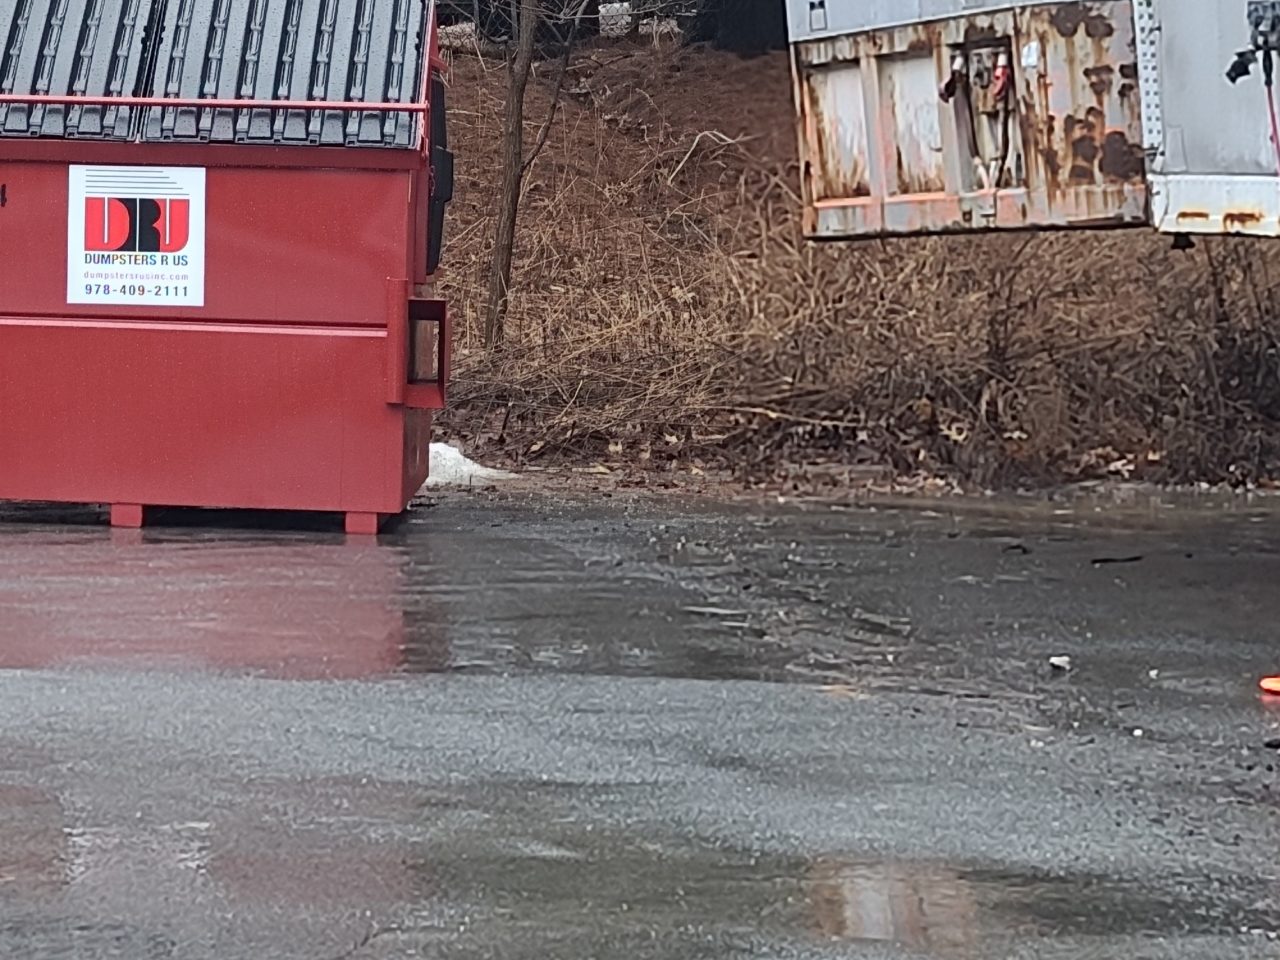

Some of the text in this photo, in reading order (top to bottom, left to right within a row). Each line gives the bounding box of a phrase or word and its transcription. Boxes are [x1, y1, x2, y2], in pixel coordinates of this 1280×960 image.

[84, 196, 190, 253] DRU
[84, 253, 189, 267] DUMPSTERS R US
[83, 270, 190, 282] dumpstersrusinc.com
[84, 283, 189, 298] 978-409-2111
